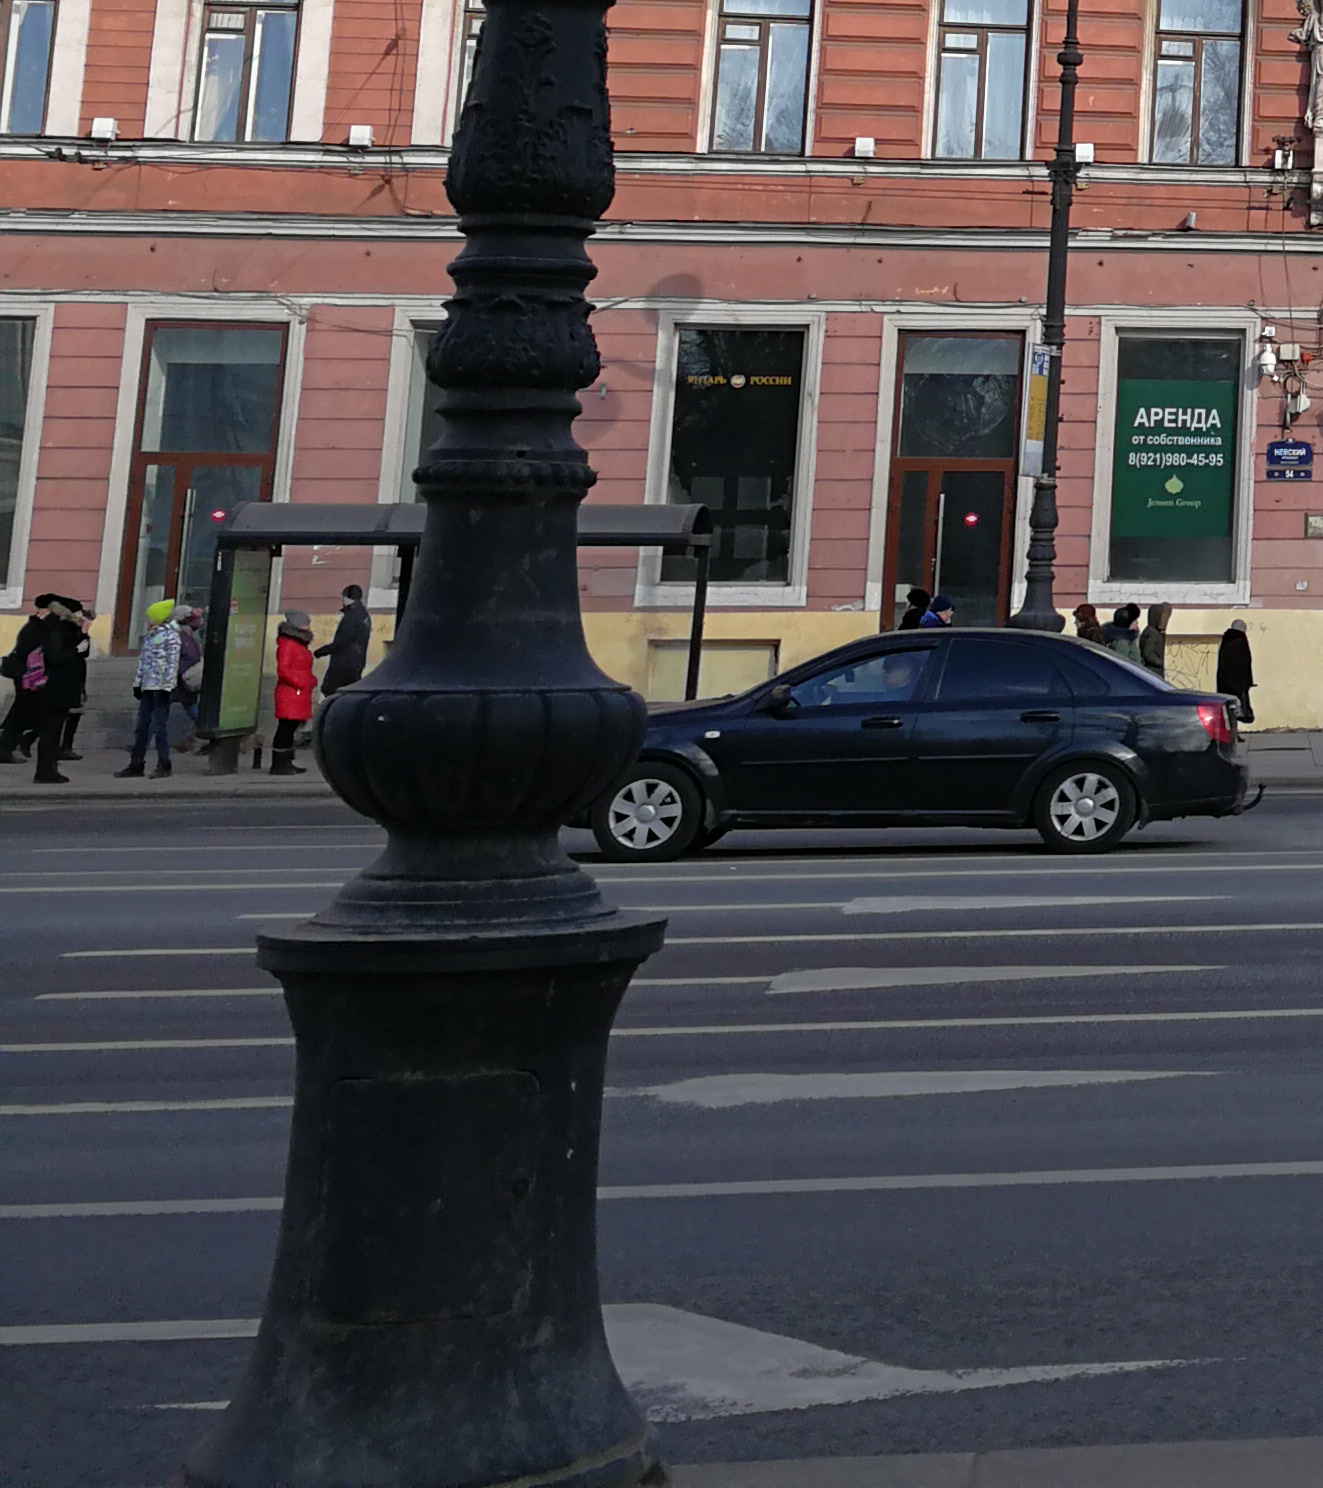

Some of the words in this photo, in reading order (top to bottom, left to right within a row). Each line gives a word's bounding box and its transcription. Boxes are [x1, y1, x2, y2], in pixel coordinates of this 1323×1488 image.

[750, 375, 792, 385] РОССИИ
[1133, 407, 1222, 432] АРЕНДА
[1132, 435, 1145, 445] от
[1147, 433, 1223, 446] собственника
[1274, 447, 1307, 456] НЕВСКИЙ
[1128, 452, 1224, 469] 8(921)980-45-95
[1176, 498, 1202, 509] Group
